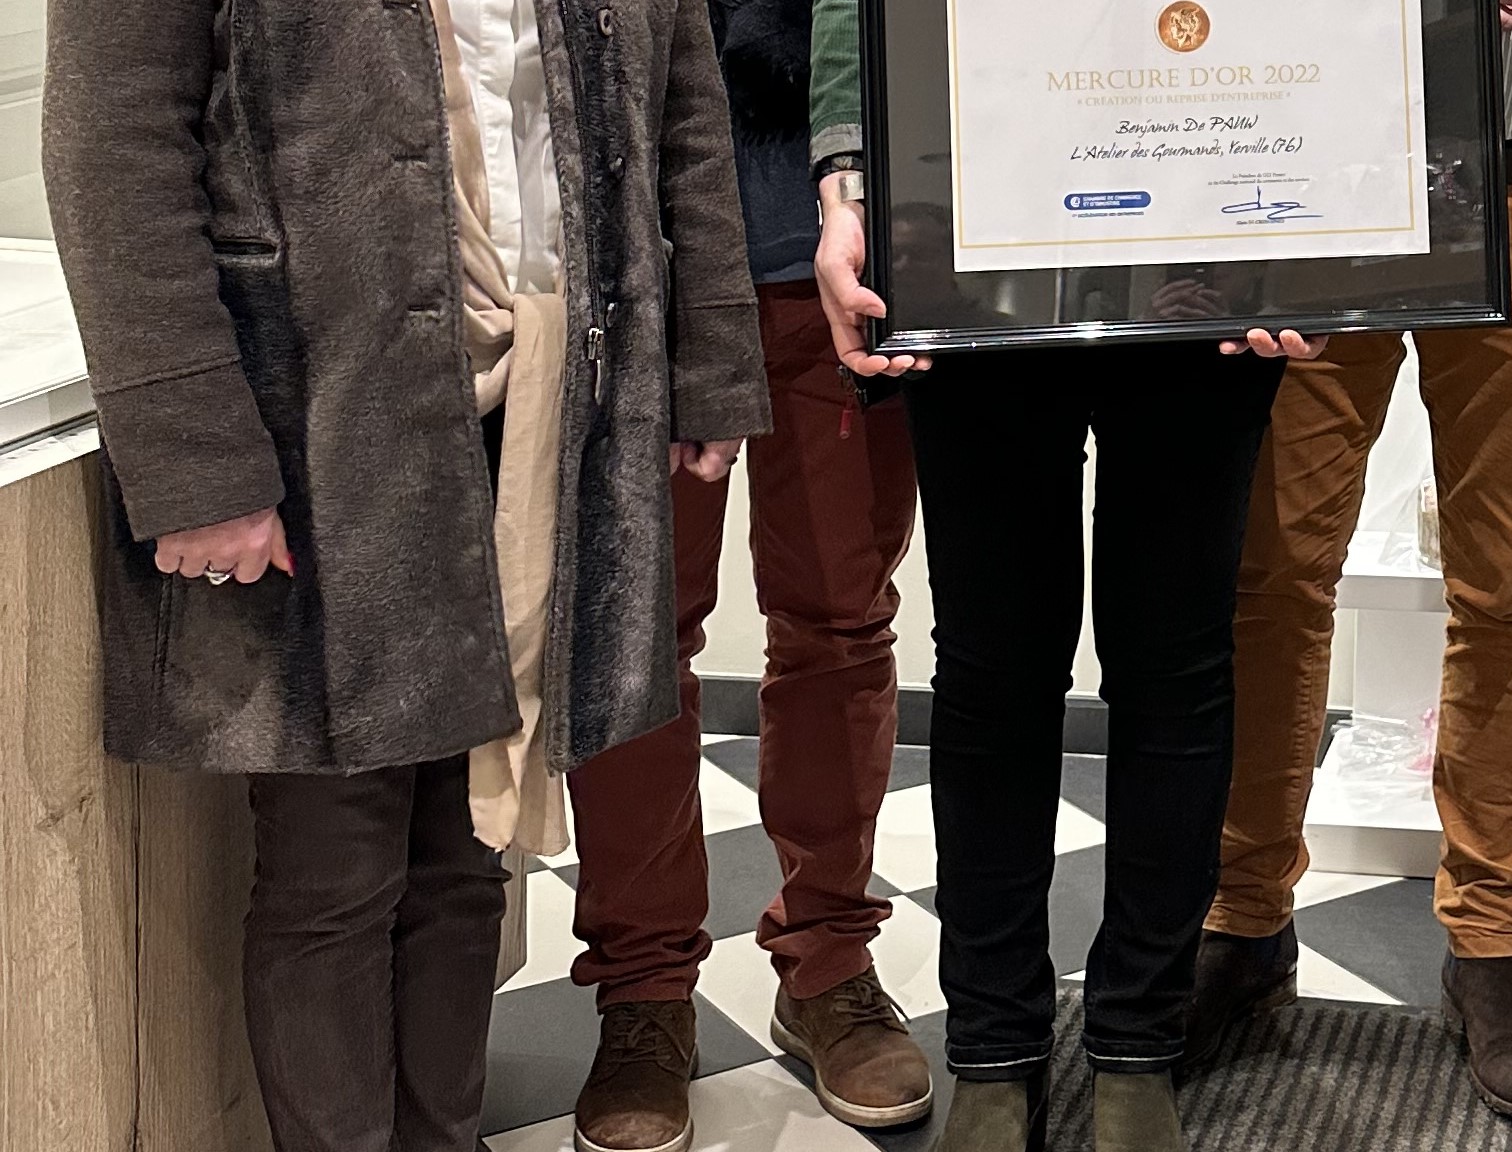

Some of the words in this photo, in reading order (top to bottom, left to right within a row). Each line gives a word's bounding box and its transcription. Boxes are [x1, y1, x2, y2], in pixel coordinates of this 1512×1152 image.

[1047, 67, 1181, 92] MERCURE
[1190, 65, 1255, 88] D'OR
[1264, 63, 1322, 86] 2022
[1145, 94, 1164, 105] OU
[1166, 93, 1208, 104] REPRISE
[1211, 90, 1284, 103] D'ENTREPRISE
[1115, 118, 1180, 139] Benjamin
[1183, 117, 1206, 133] De
[1070, 141, 1130, 162] L'Atelier
[1130, 141, 1148, 159] des
[1151, 139, 1224, 163] Gourmands,
[1228, 136, 1270, 156] Yerville
[1271, 136, 1303, 155] (76)
